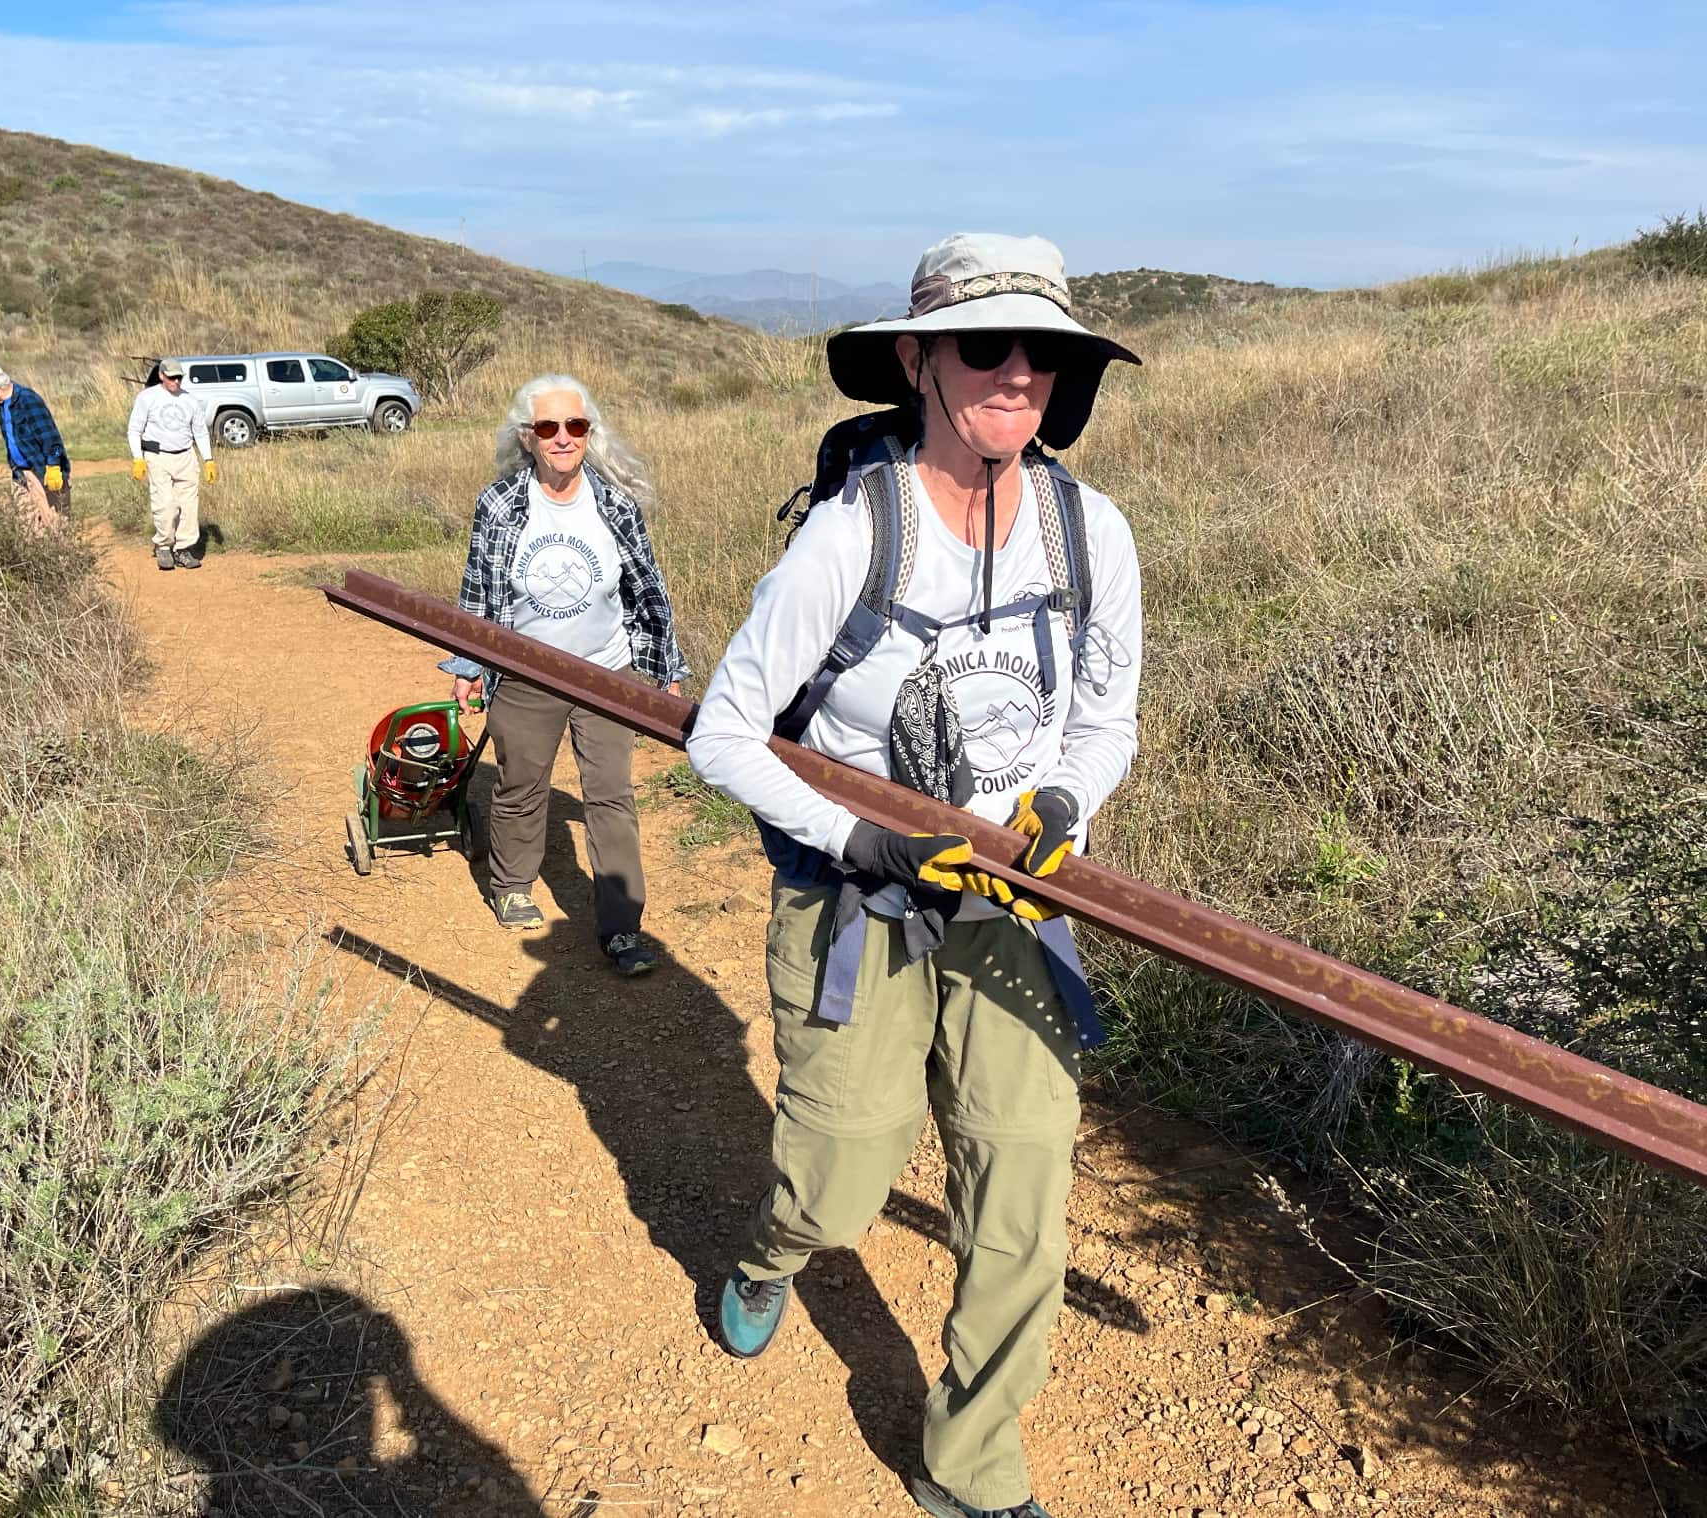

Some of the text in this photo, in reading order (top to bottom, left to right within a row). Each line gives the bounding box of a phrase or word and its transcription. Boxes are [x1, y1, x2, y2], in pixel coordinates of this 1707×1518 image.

[516, 533, 603, 582] SANTA MONICA MOUNTAINS
[526, 596, 592, 620] TRAILS COUNCIL
